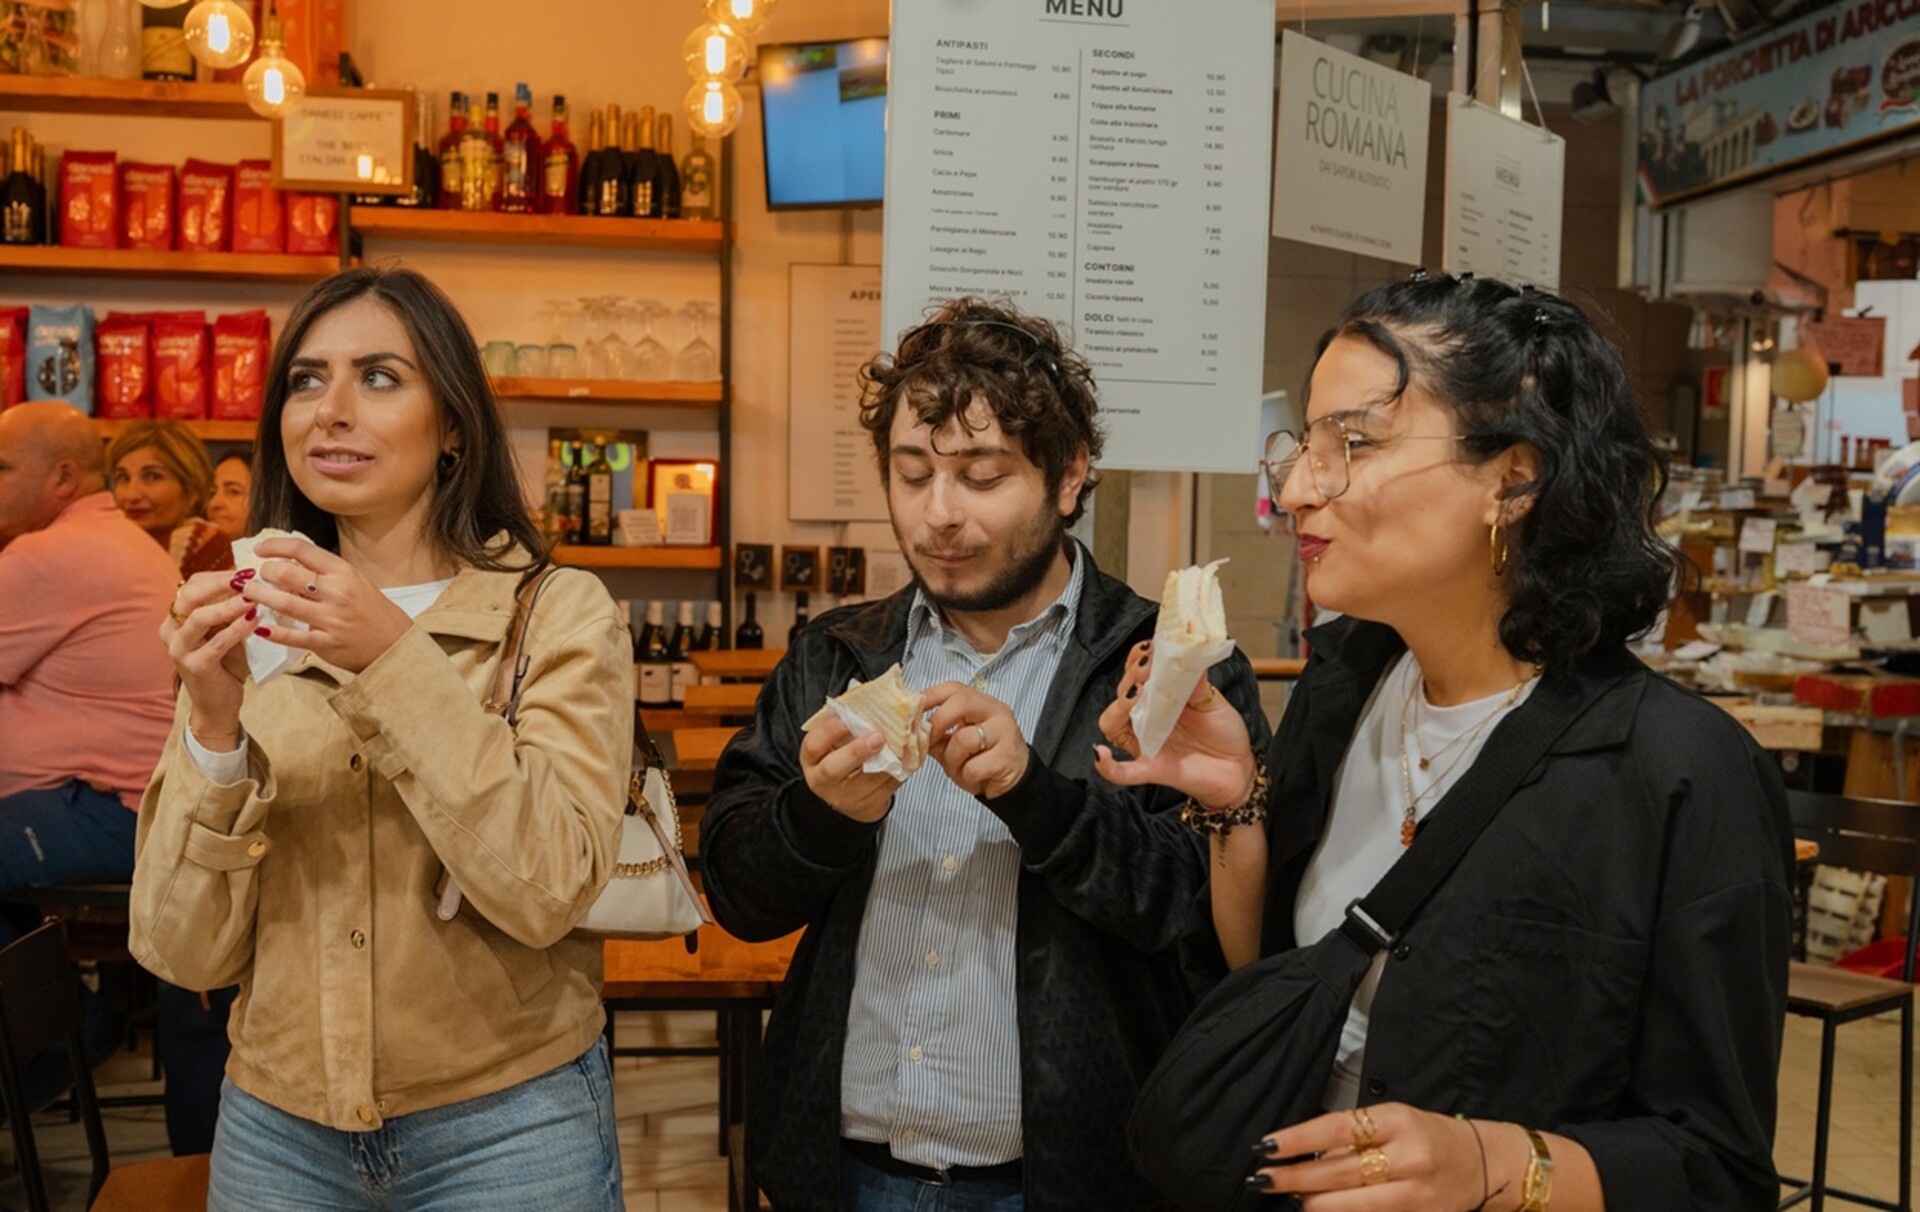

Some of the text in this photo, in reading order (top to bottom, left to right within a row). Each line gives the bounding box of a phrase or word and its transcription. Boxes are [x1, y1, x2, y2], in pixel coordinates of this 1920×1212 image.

[1046, 0, 1124, 18] MENU
[936, 39, 988, 50] ANTIPASTI
[1093, 49, 1135, 59] SECONDI
[1004, 61, 1037, 71] Formaggi
[1676, 73, 1699, 106] LA
[1703, 28, 1812, 97] PORCHETTA
[1815, 16, 1836, 53] DI
[1313, 57, 1399, 123] CUCINA
[934, 111, 960, 119] PRIMI
[933, 128, 970, 137] Carbonara
[1306, 101, 1407, 170] ROMANA
[1088, 176, 1126, 186] Hamburger
[932, 189, 974, 197] Amatriciana
[931, 225, 970, 234] Parmigiana
[1084, 262, 1134, 272] CONTORNI
[1084, 313, 1114, 322] DOLCI
